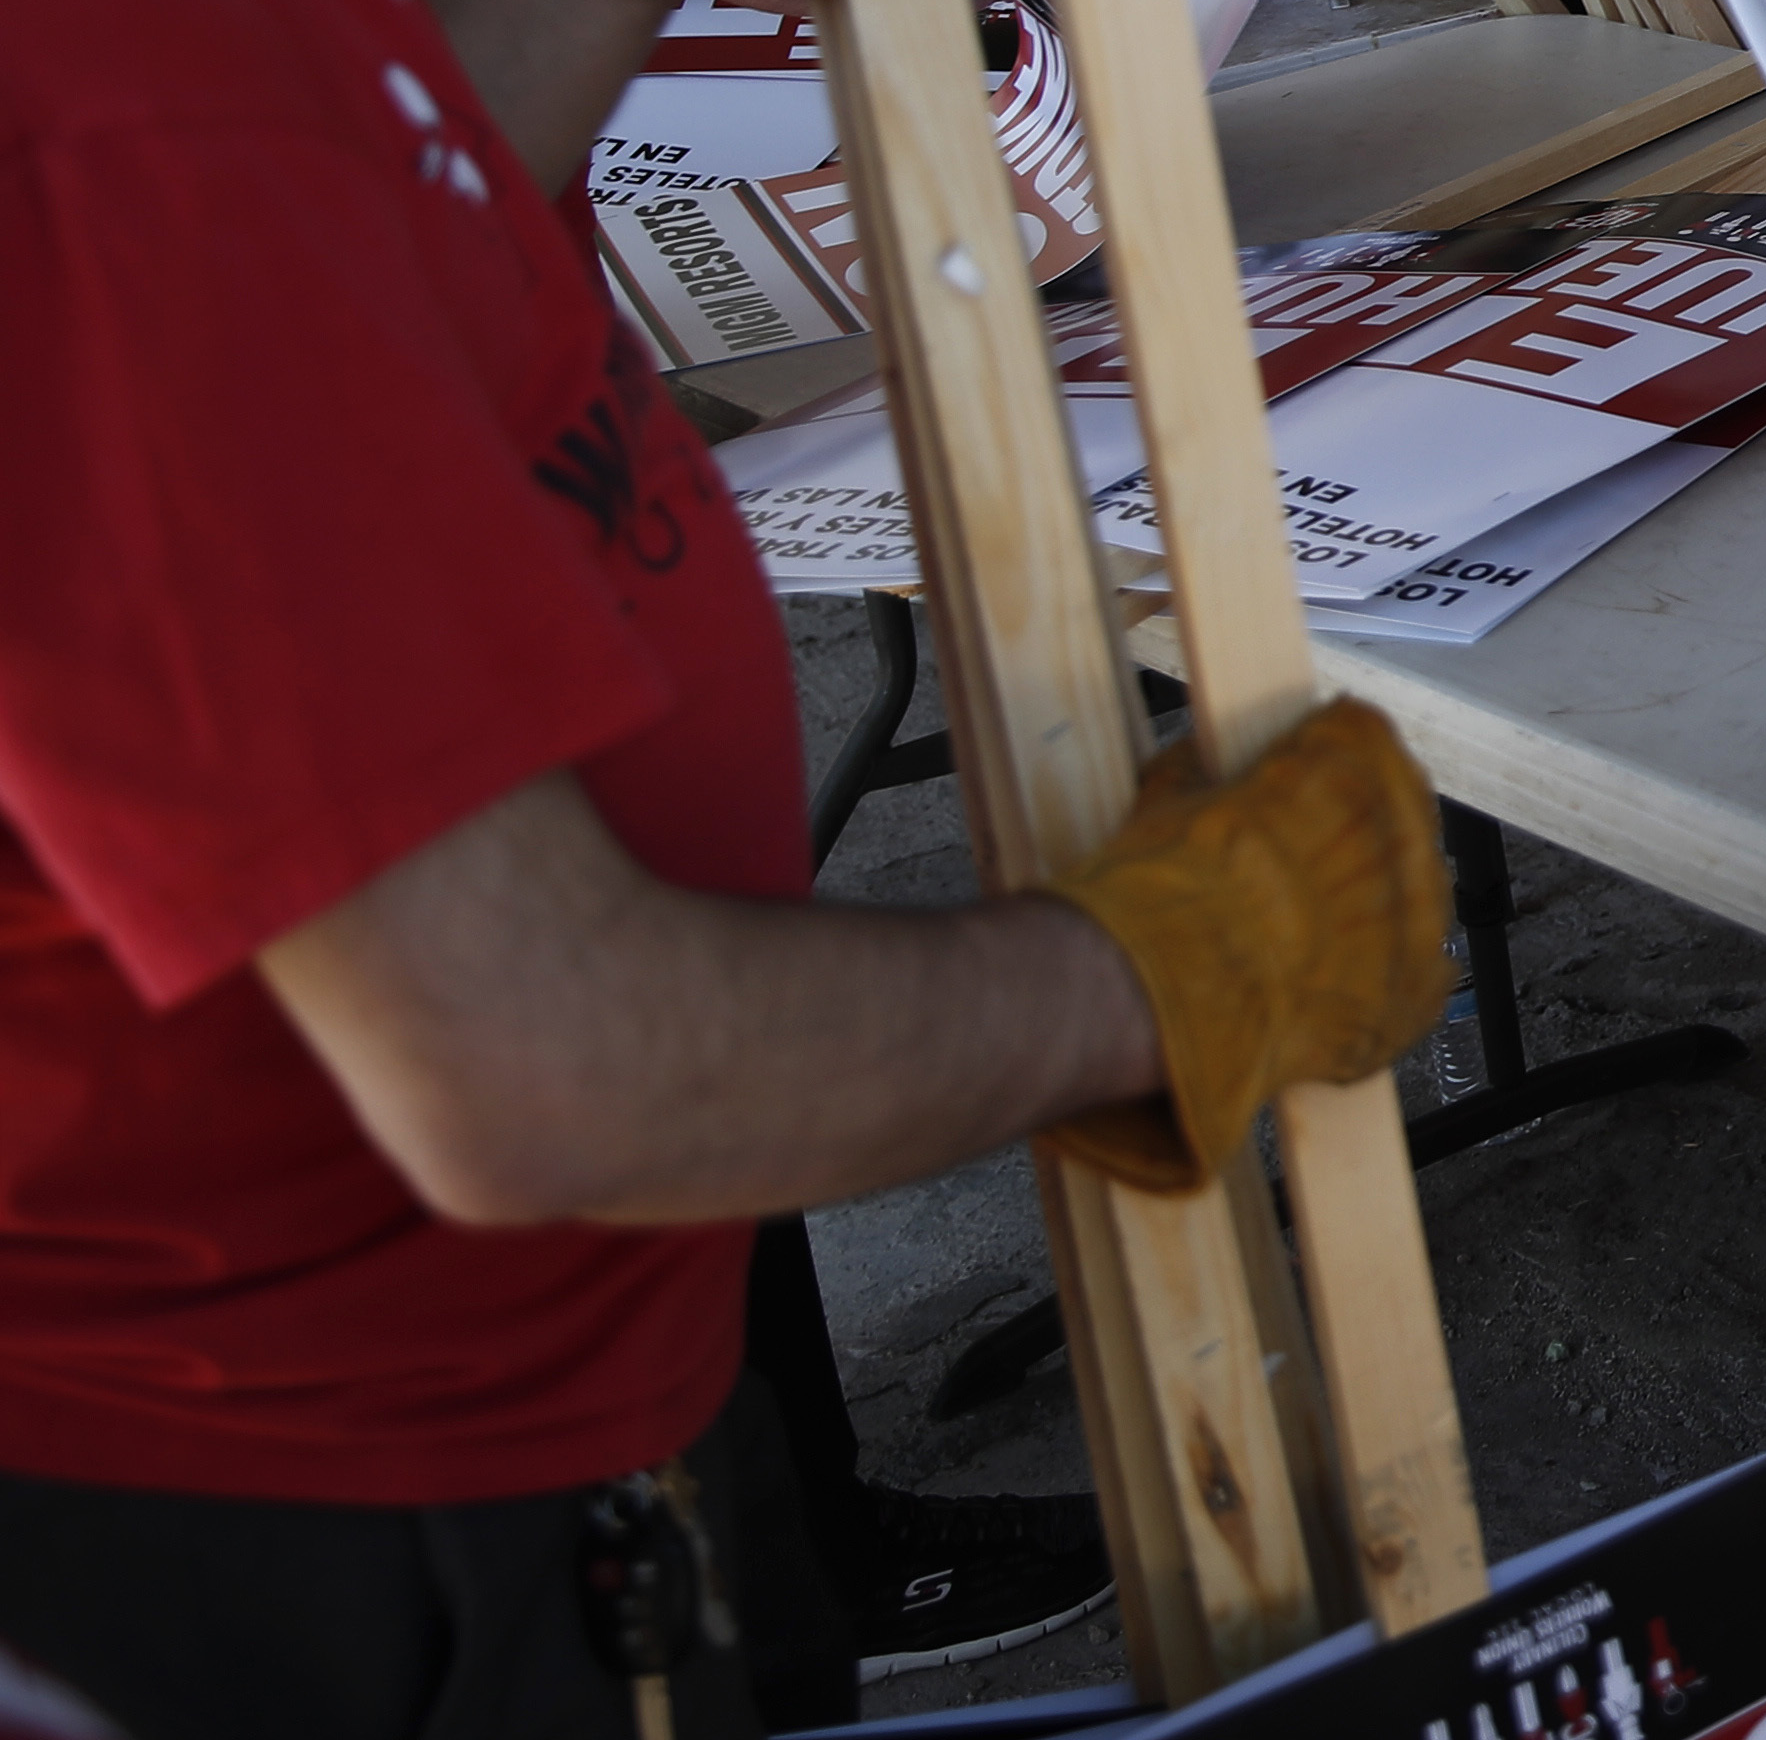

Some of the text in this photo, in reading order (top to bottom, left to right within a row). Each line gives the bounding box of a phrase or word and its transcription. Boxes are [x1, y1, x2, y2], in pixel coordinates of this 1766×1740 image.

[629, 142, 691, 164] EN
[632, 197, 798, 353] MGM RESORTS
[773, 486, 844, 504] LAS
[1284, 475, 1360, 505] EN
[778, 512, 817, 532] Y
[1475, 1590, 1614, 1668] WORKERS UNION
[1510, 1623, 1590, 1673] CULINARY
